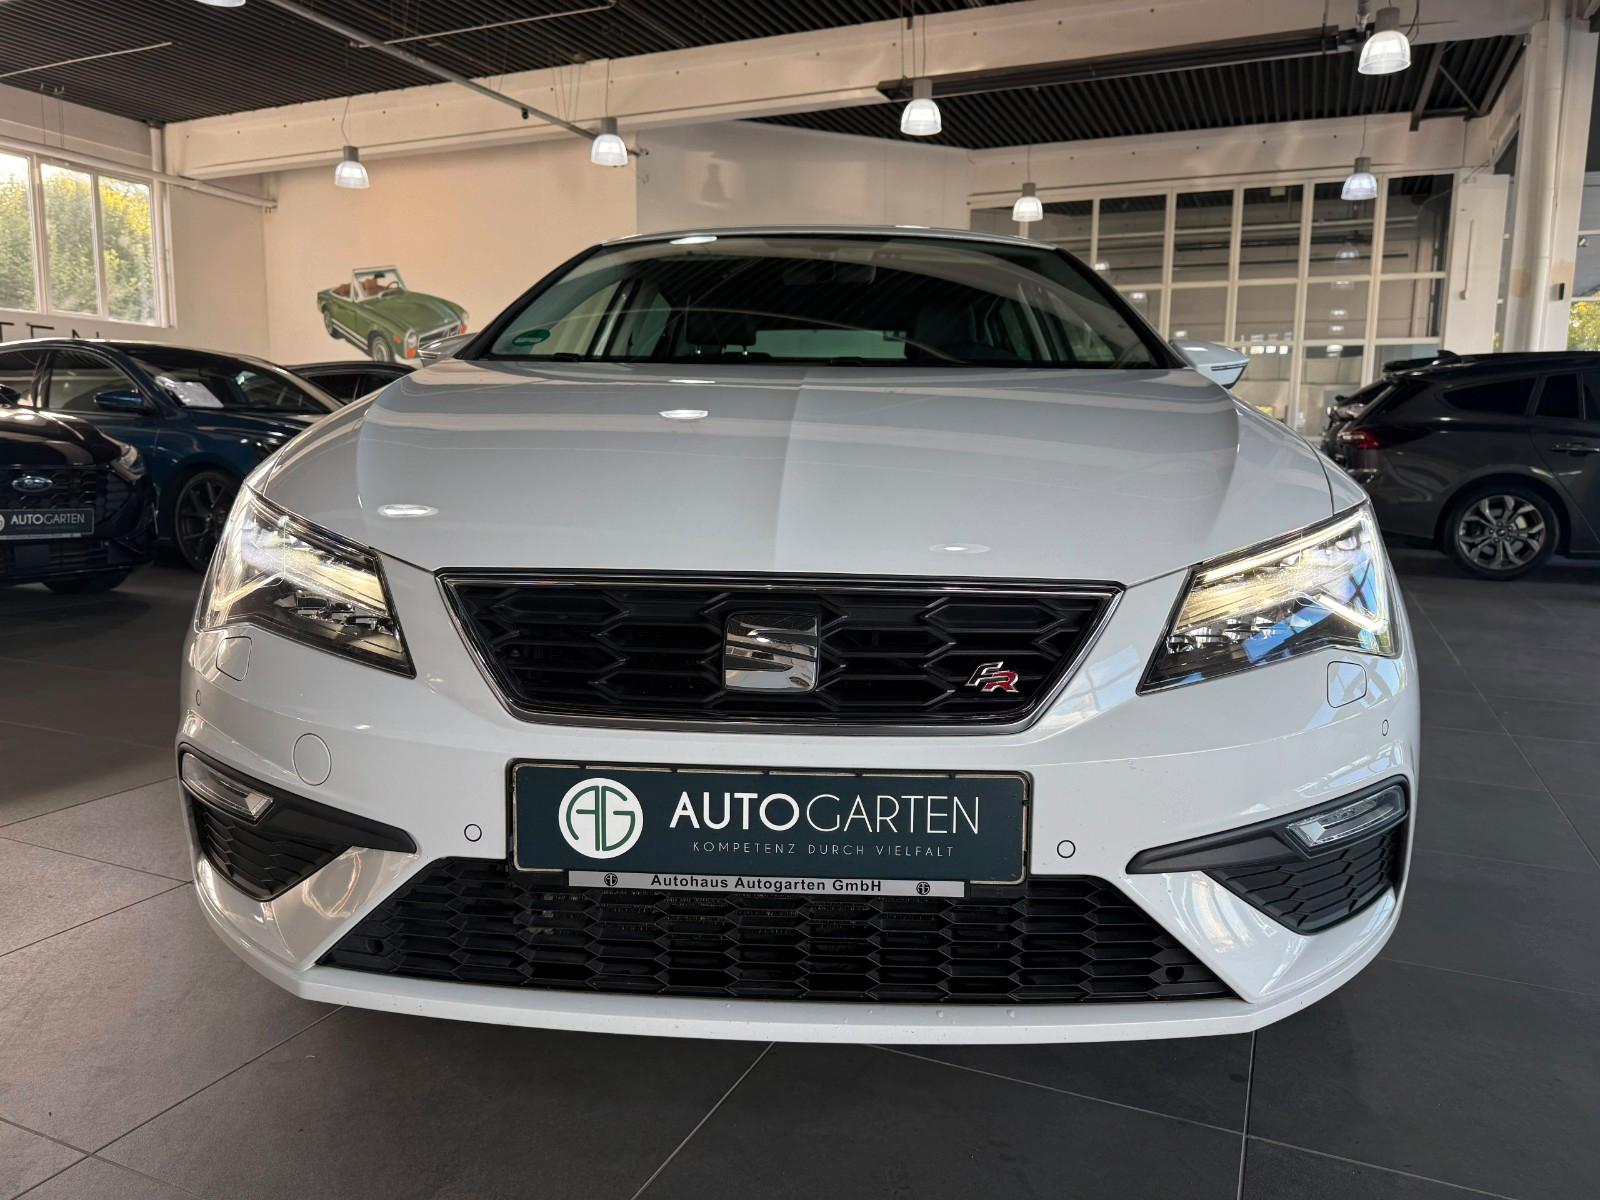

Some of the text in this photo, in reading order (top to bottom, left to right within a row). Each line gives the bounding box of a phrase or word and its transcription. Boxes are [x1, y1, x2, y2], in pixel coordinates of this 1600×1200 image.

[10, 513, 85, 525] AUTOGARTEN
[669, 791, 980, 834] AUTOGARTEN
[693, 841, 953, 857] KOMPETENZ DURCH VIELFALT
[651, 875, 729, 889] Autohaus
[735, 877, 826, 892] Autogarten
[832, 879, 881, 892] GmbH
